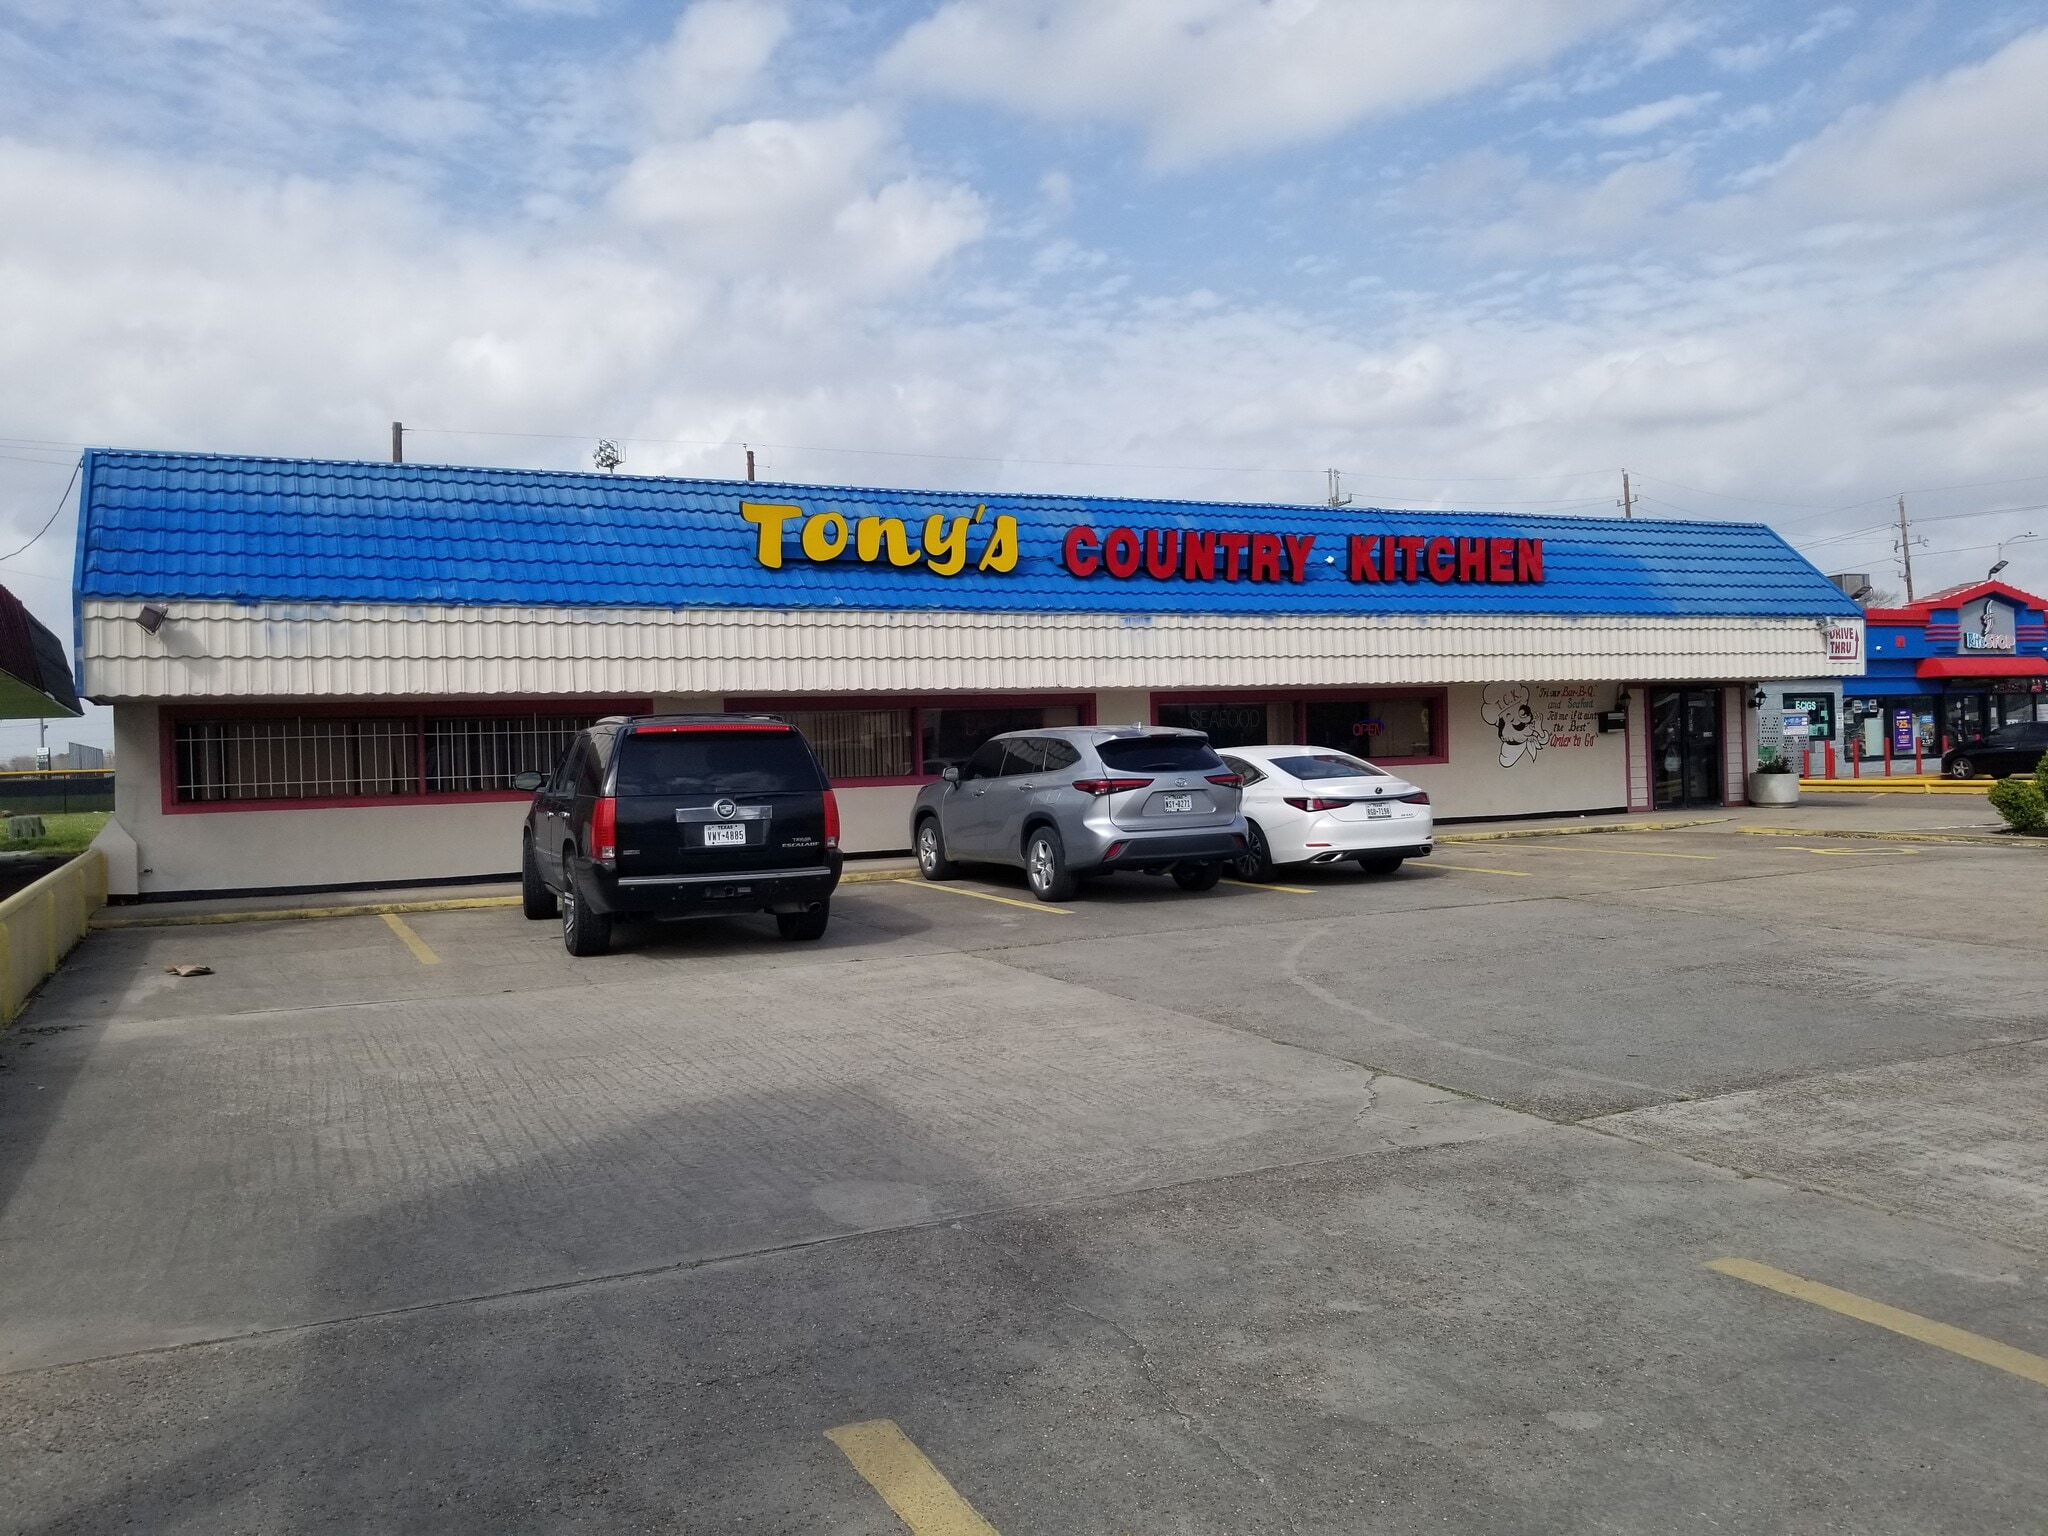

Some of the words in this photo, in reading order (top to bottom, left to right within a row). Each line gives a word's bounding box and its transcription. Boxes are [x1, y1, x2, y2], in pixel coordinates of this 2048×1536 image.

[741, 501, 1018, 576] Tony's
[1064, 526, 1316, 583] COUNTRY
[1349, 534, 1544, 584] KITCHEN
[1829, 627, 1854, 640] DRIVE
[1829, 641, 1852, 654] THRU
[1547, 700, 1561, 710] and
[1190, 709, 1260, 730] SEAFOOD
[1547, 710, 1558, 721] Tell
[1571, 710, 1577, 720] if
[1352, 723, 1383, 737] OPEN
[1553, 723, 1564, 732] the
[1573, 733, 1582, 747] to
